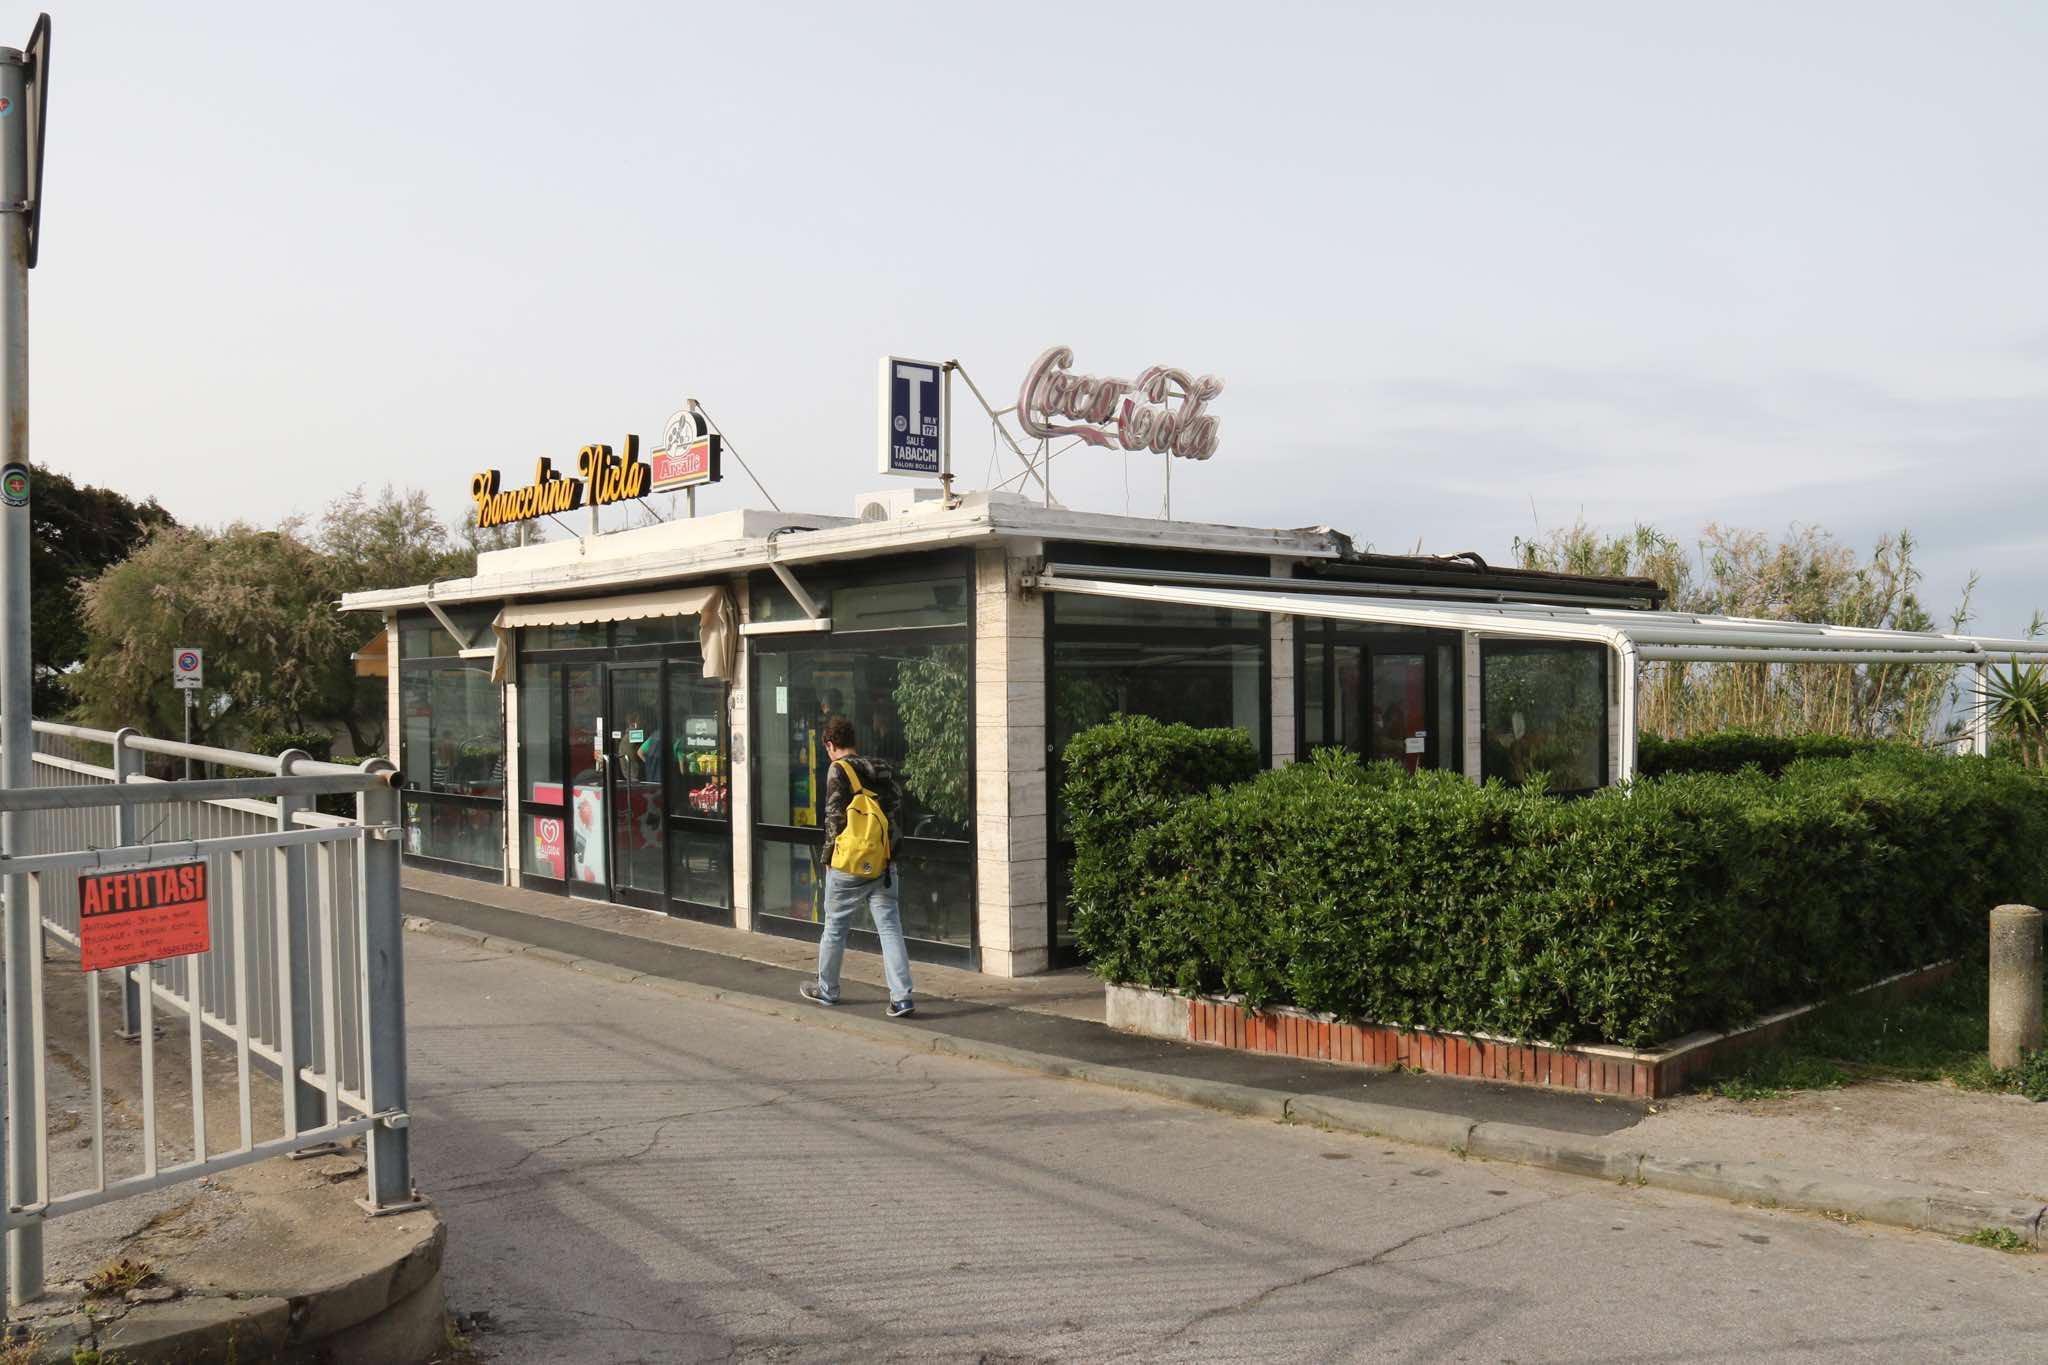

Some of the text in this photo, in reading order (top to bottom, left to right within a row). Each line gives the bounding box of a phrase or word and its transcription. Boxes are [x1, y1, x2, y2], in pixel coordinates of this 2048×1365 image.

[897, 365, 933, 434] T
[895, 446, 936, 462] TABACCHI
[907, 436, 925, 447] SALI E
[472, 434, 648, 528] Baracchina Nicla
[915, 463, 937, 471] BOLLATI
[84, 865, 203, 913] AFFITTASI
